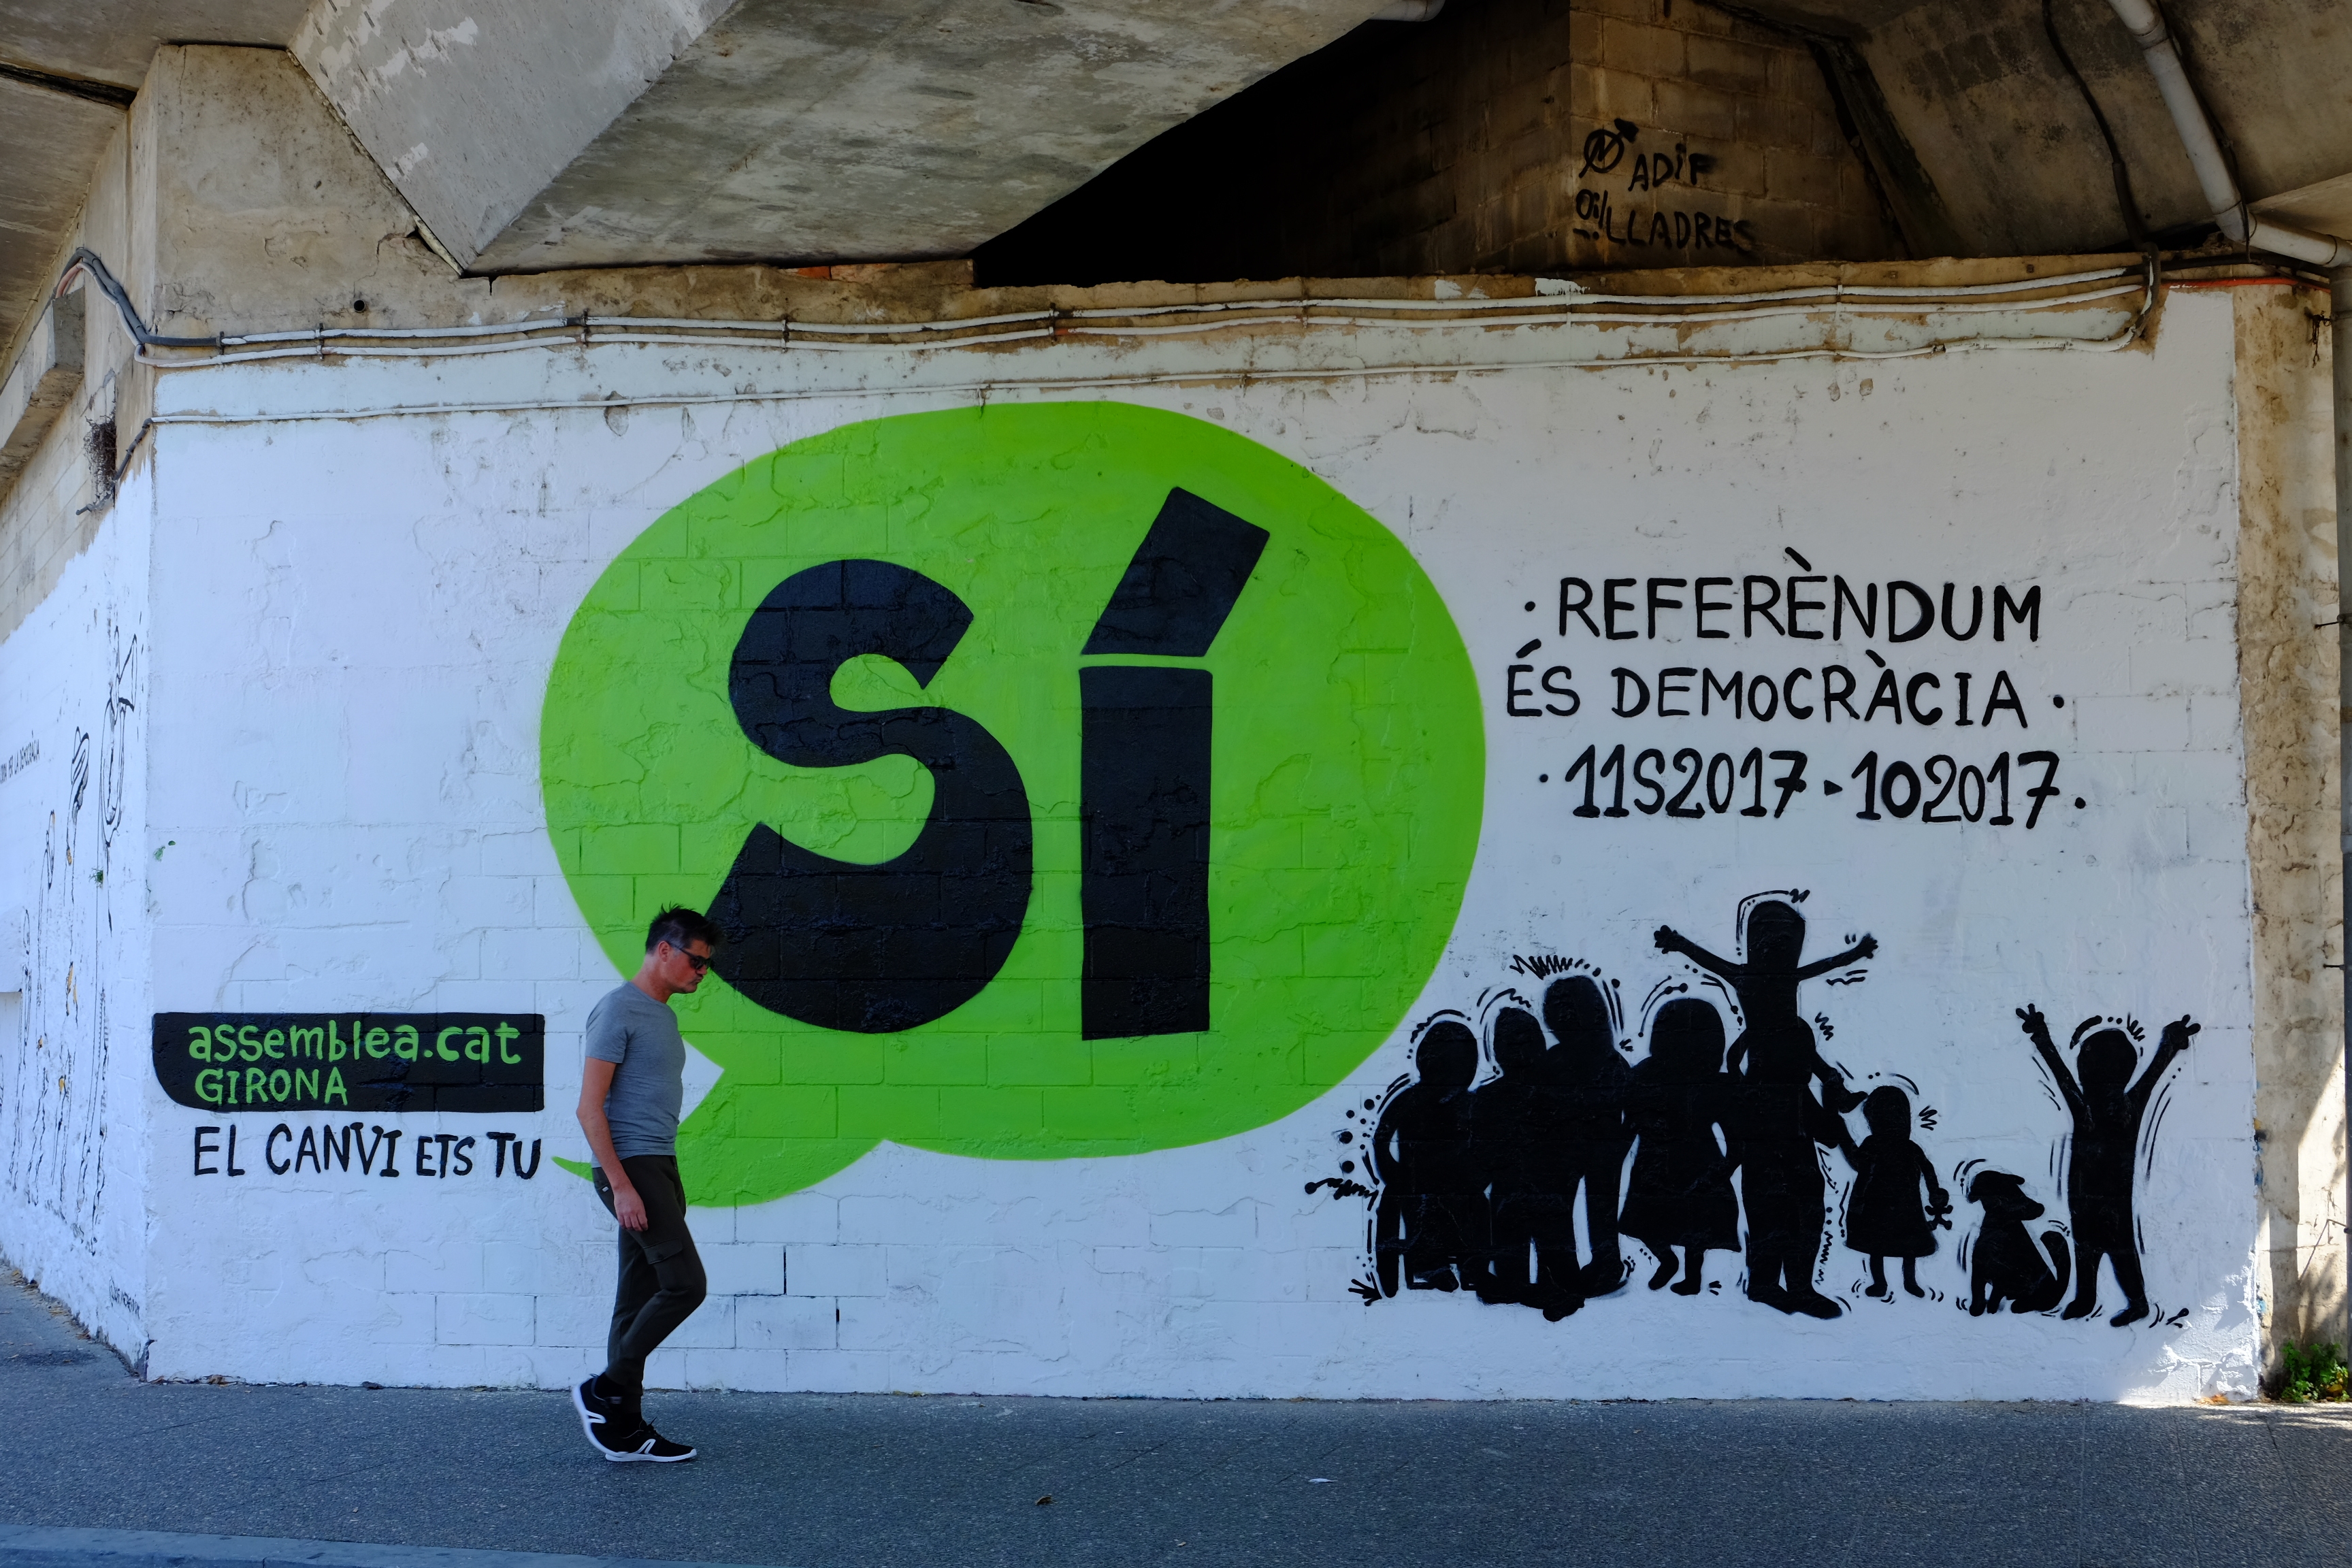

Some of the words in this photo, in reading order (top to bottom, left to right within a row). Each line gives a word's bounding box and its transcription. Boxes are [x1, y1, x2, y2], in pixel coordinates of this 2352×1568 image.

[1558, 546, 2041, 642] REFERÈNDUM
[1506, 639, 1581, 717] ÉS
[1610, 649, 2028, 729] DEMOCRÀCIA
[187, 1019, 521, 1064] assemblea.cat
[194, 1066, 348, 1106] GIRONA
[193, 1125, 246, 1177] EL
[265, 1122, 403, 1178] CANVI
[415, 1134, 475, 1179] ETS
[486, 1131, 542, 1180] TU
